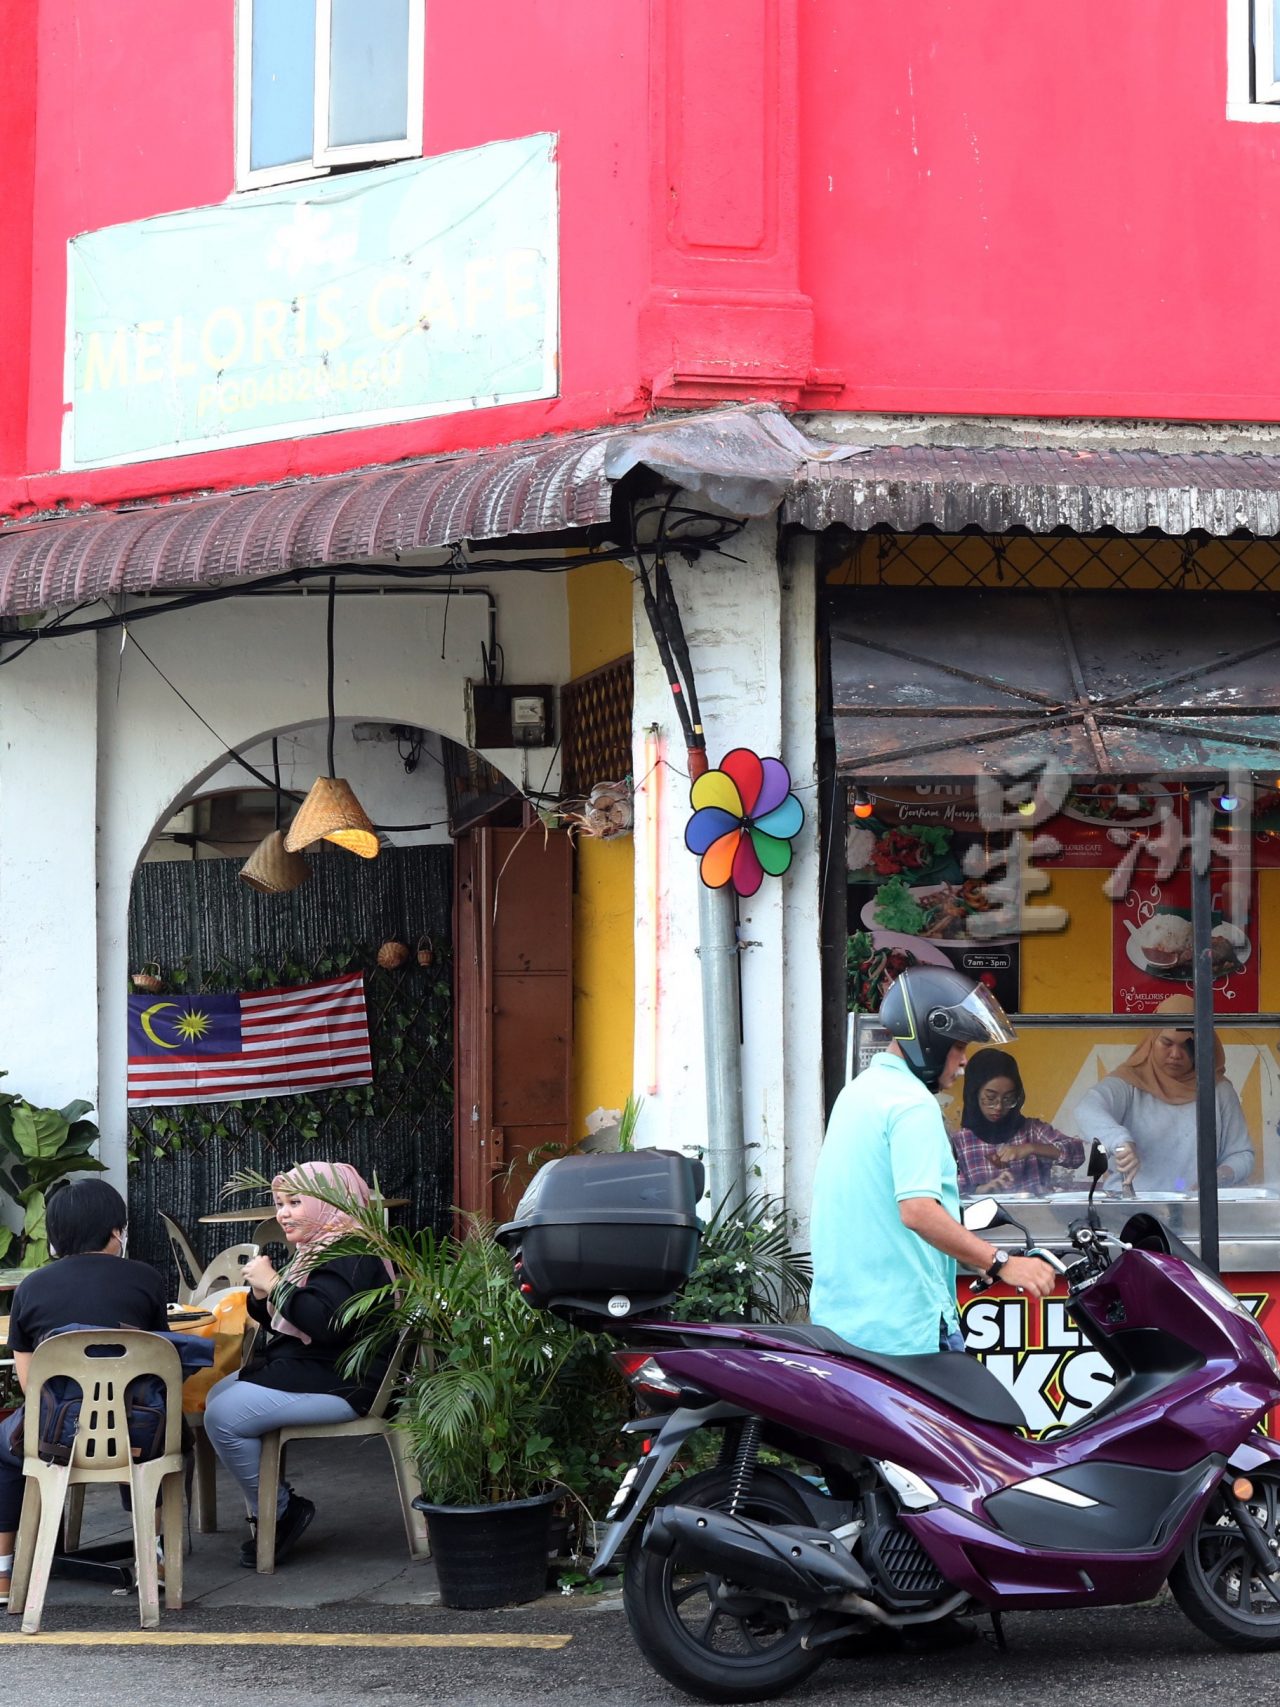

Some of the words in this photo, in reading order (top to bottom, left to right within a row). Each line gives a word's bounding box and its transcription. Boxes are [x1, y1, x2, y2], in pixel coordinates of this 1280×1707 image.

[83, 287, 346, 394] MELORIS
[366, 249, 539, 343] CAFE
[990, 959, 1007, 968] 3pm
[758, 1353, 833, 1380] PCX
